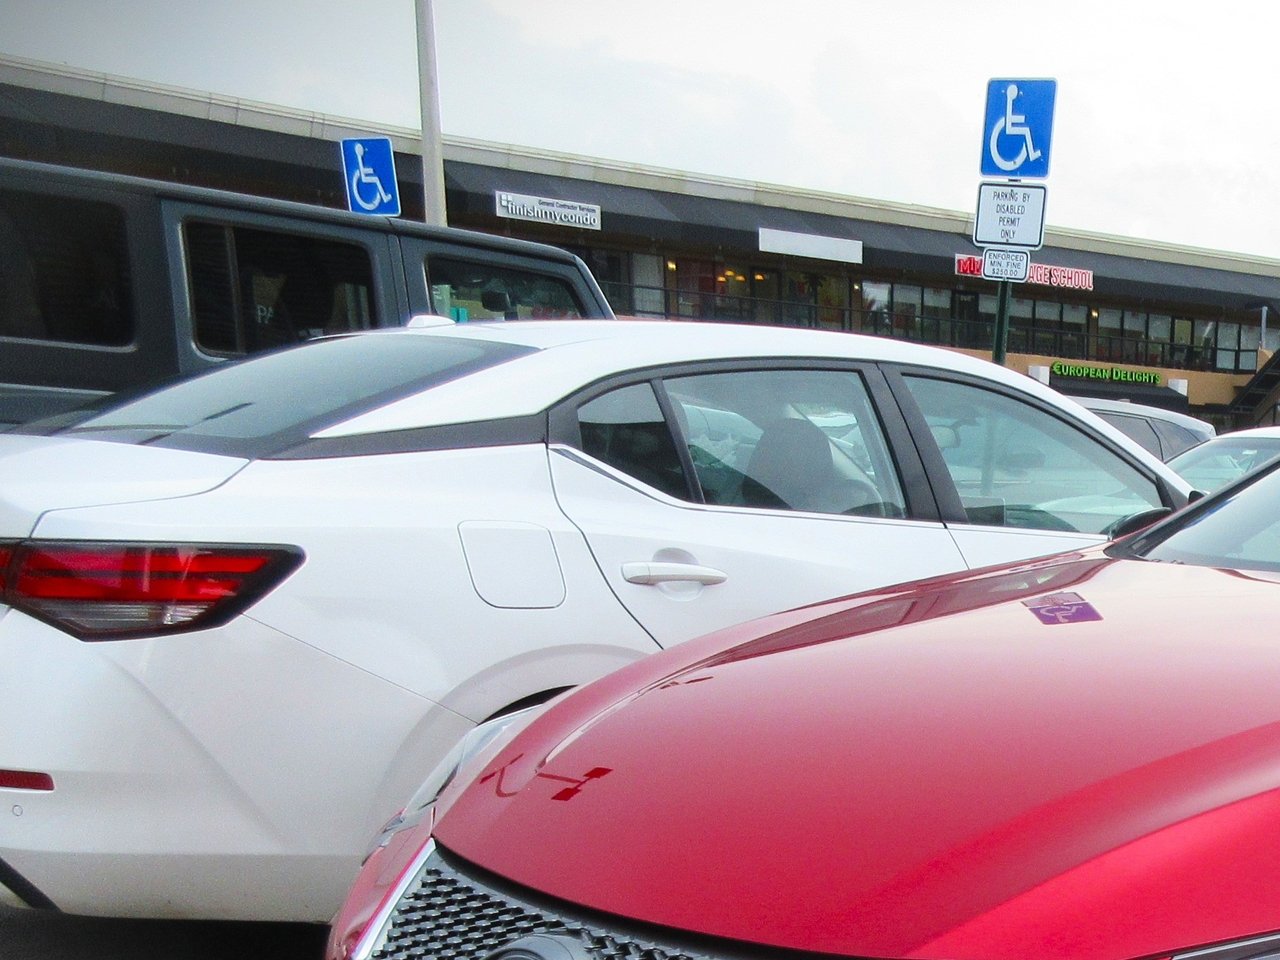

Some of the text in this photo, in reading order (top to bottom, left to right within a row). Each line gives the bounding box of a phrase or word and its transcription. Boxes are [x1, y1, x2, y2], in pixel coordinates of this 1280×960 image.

[992, 190, 1031, 202] PARKING BY
[507, 202, 598, 226] finishmycondo
[996, 204, 1025, 215] DISABLED
[998, 216, 1020, 227] PERMIT
[1000, 229, 1016, 239] ONLY
[988, 253, 1024, 262] ENFORCED
[990, 260, 1021, 270] MIN. FINE
[991, 268, 1018, 277] $250.00
[1027, 265, 1050, 284] AGE
[1050, 267, 1094, 289] SCHOOL
